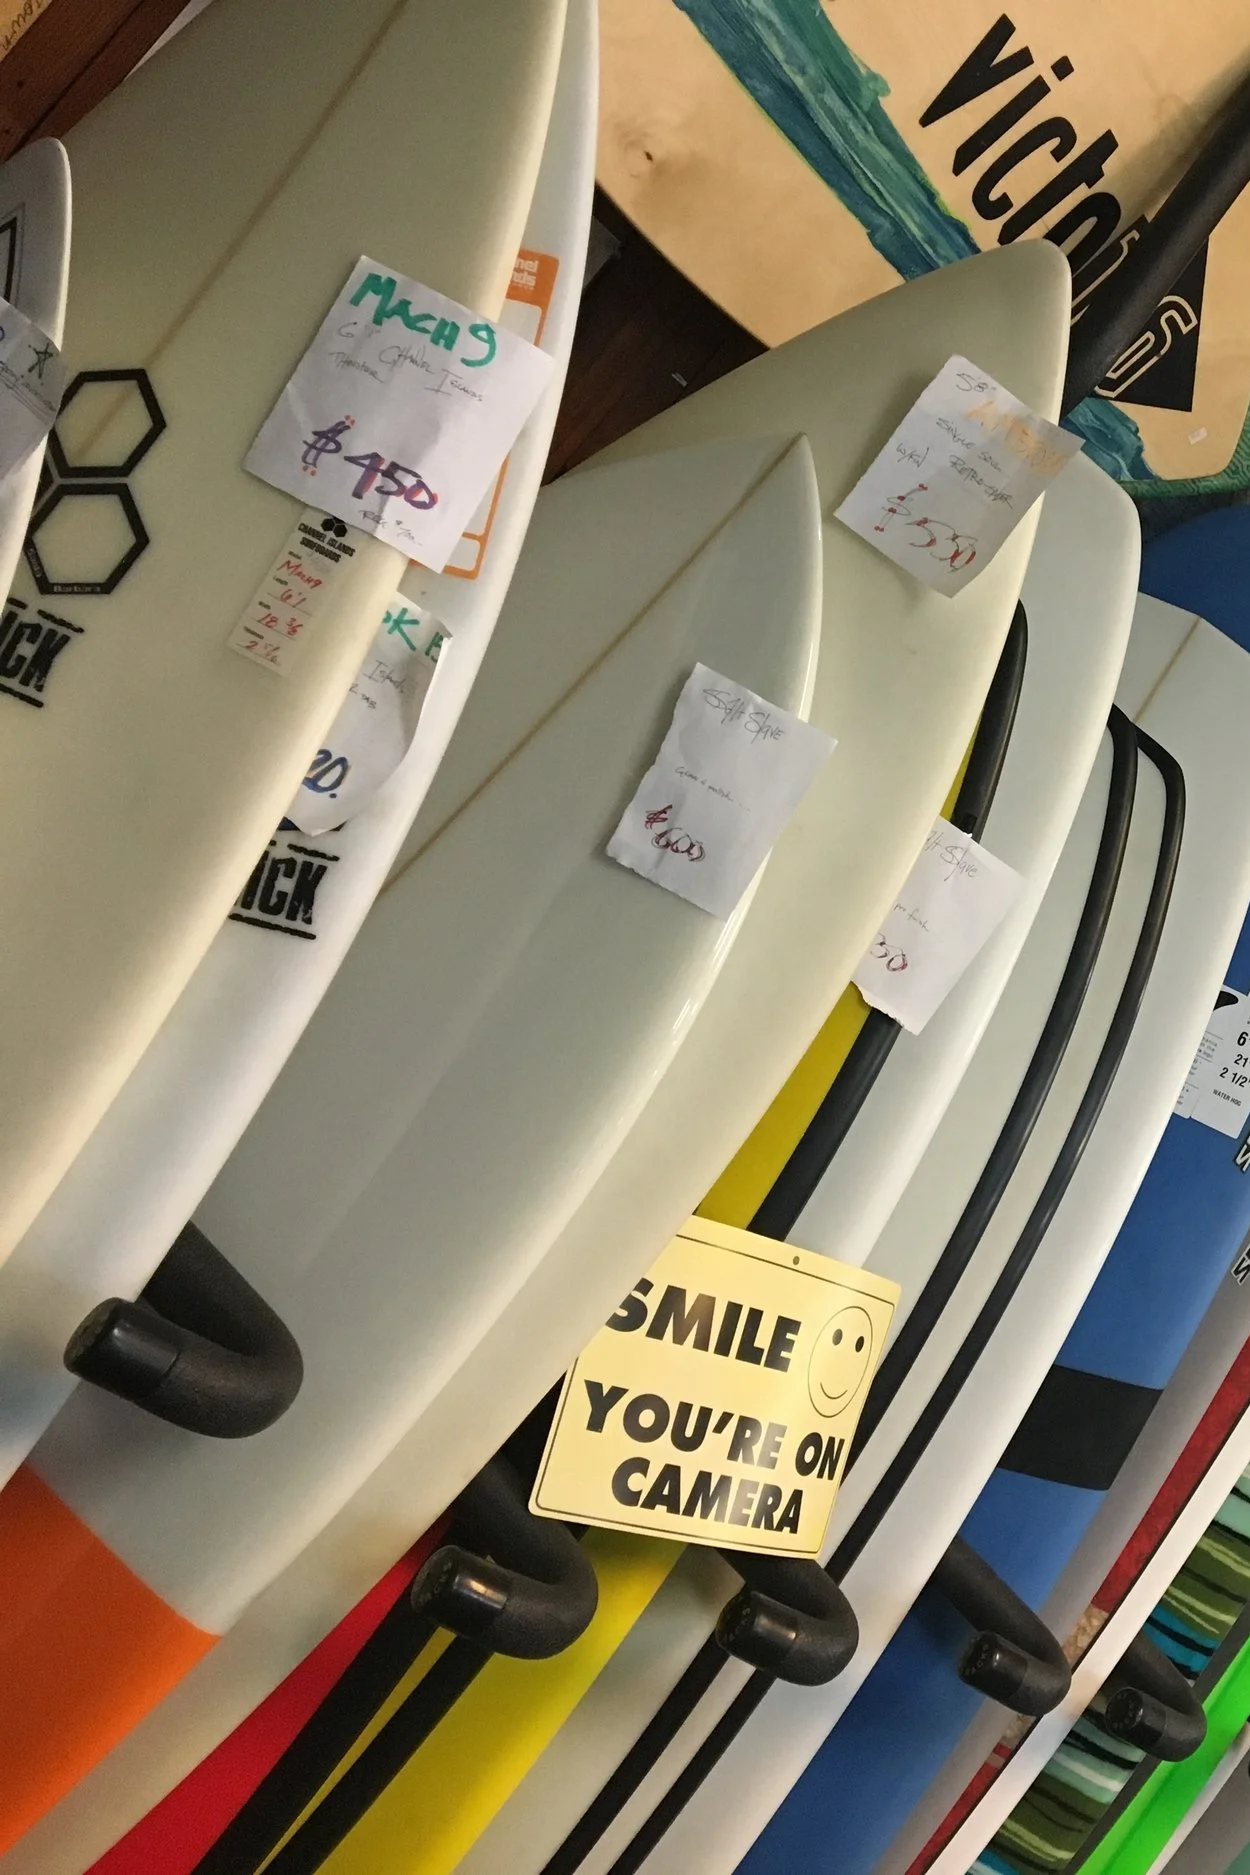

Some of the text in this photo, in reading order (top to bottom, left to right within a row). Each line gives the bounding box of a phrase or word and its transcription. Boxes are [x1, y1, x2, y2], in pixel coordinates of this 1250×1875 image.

[350, 272, 497, 368] MACH 9
[297, 521, 356, 557] CHANNEL ISLANDS
[299, 536, 342, 563] SURFBOARDS
[1212, 1089, 1231, 1103] WATER
[1219, 1067, 1231, 1079] 2
[604, 1276, 802, 1374] SMILE
[583, 1379, 846, 1481] YOU'RE ON
[611, 1456, 804, 1535] CAMERA
